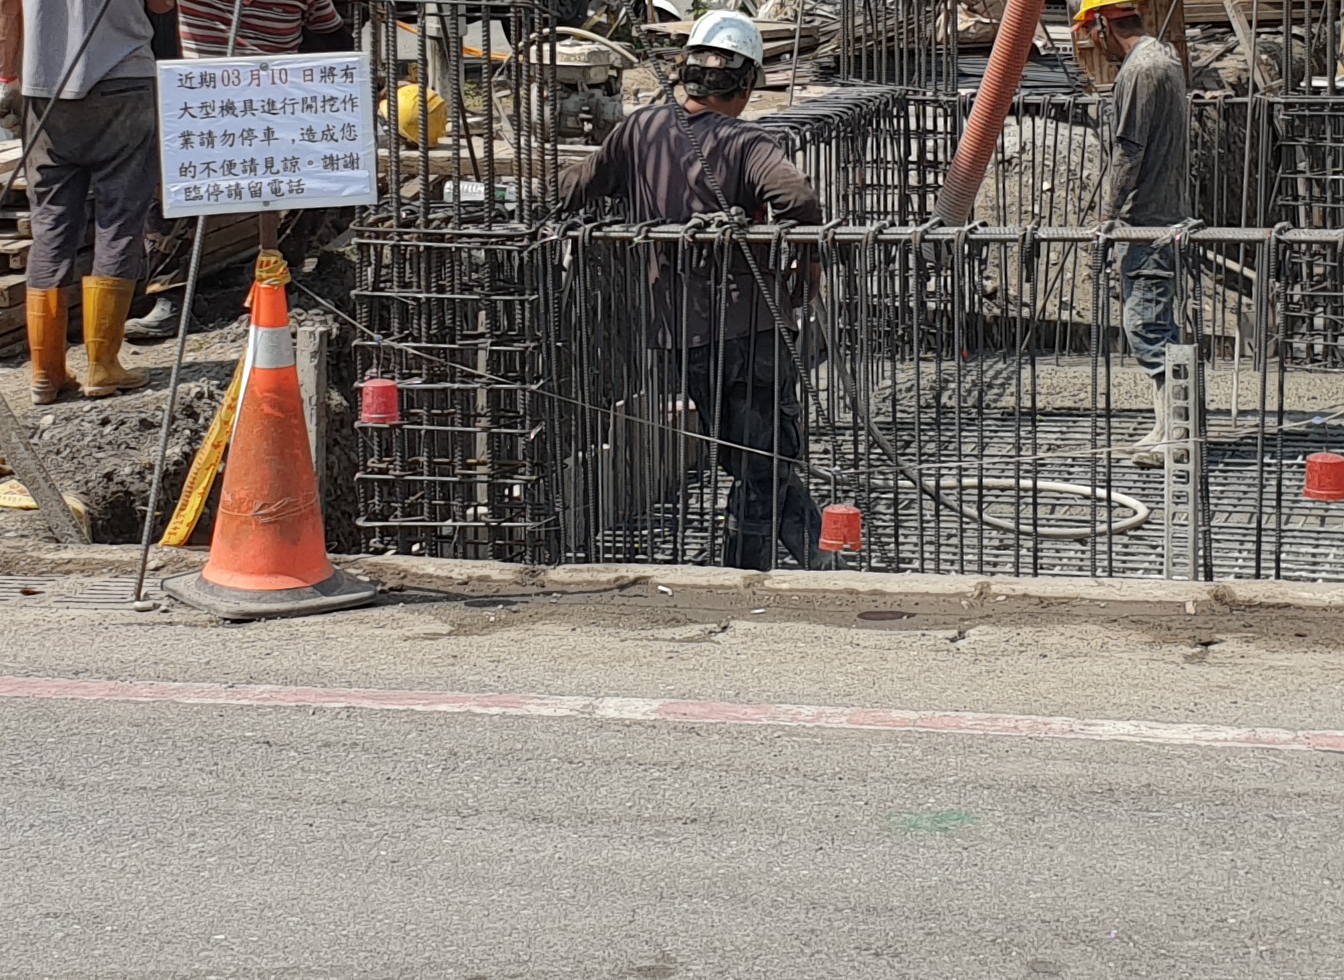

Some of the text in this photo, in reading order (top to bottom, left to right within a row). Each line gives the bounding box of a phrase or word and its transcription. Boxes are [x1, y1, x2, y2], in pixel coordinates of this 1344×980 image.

[177, 94, 359, 120] 大型機具進行開挖作
[184, 179, 306, 202] 臨停請留電話
